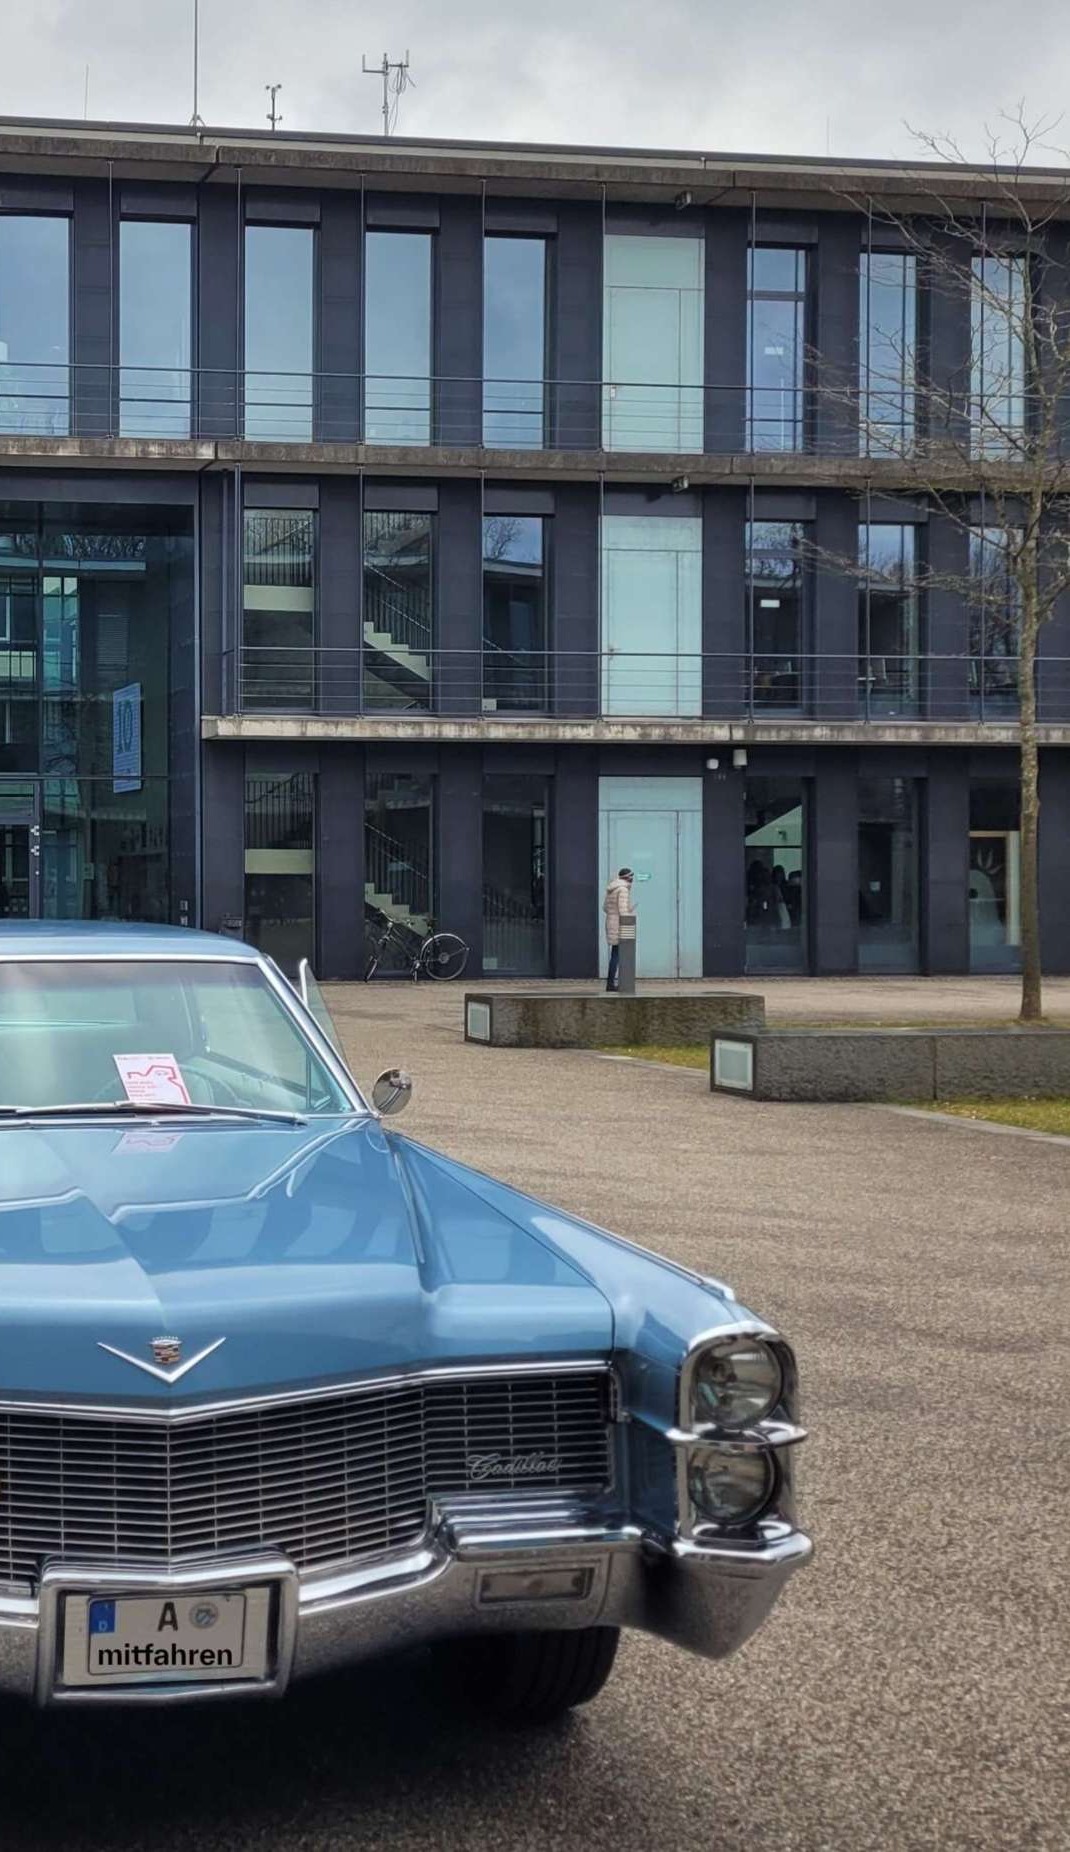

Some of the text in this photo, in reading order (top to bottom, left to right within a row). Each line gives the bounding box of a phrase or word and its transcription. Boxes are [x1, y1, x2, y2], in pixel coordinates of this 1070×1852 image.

[466, 1451, 563, 1480] Cadillac
[158, 1602, 178, 1631] A
[98, 1643, 232, 1665] mitfahren
